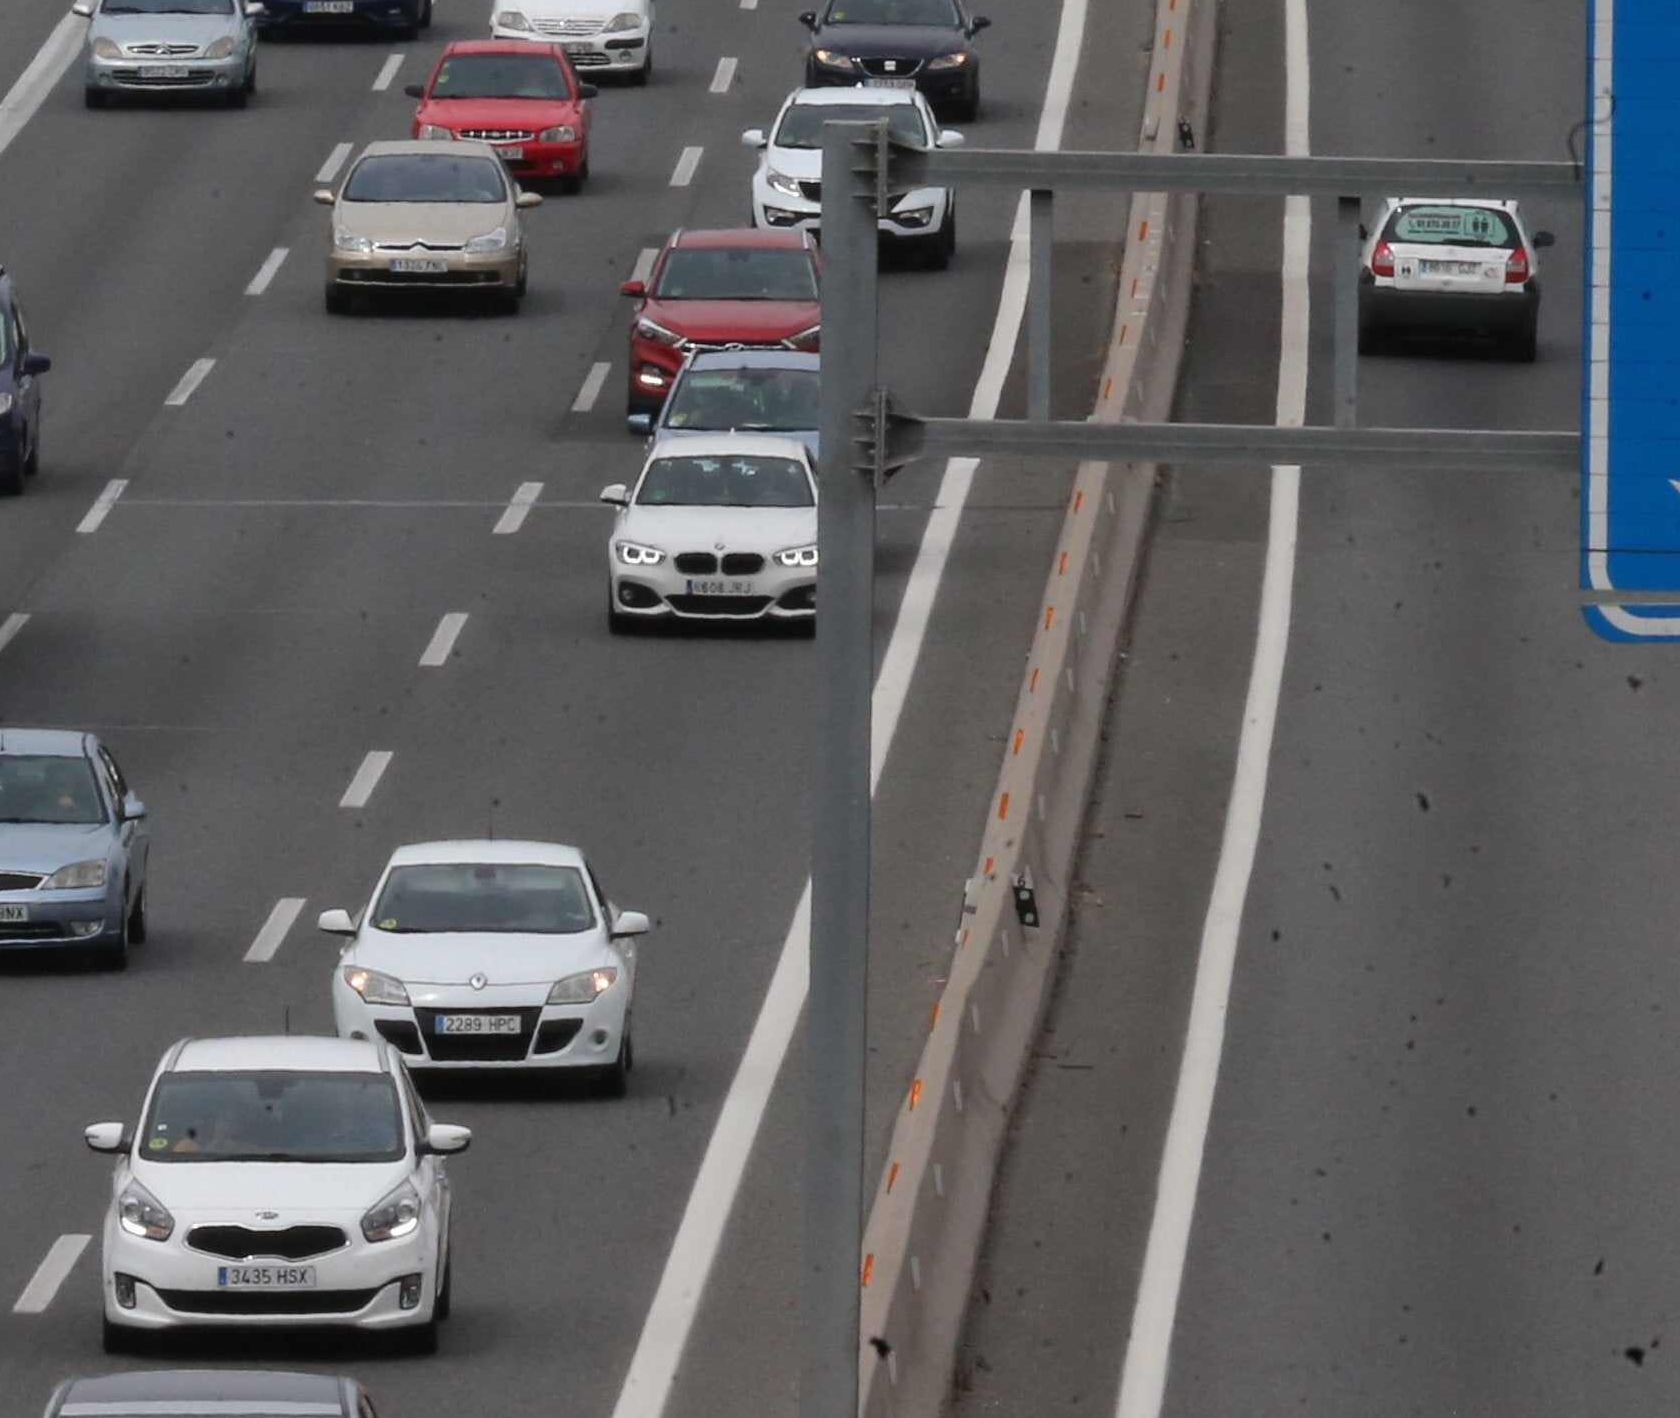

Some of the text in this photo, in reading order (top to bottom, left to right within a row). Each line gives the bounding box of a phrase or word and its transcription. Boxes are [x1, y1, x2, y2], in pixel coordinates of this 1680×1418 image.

[444, 1017, 517, 1032] 2289 HPC
[230, 1267, 308, 1284] 3435 HSX
